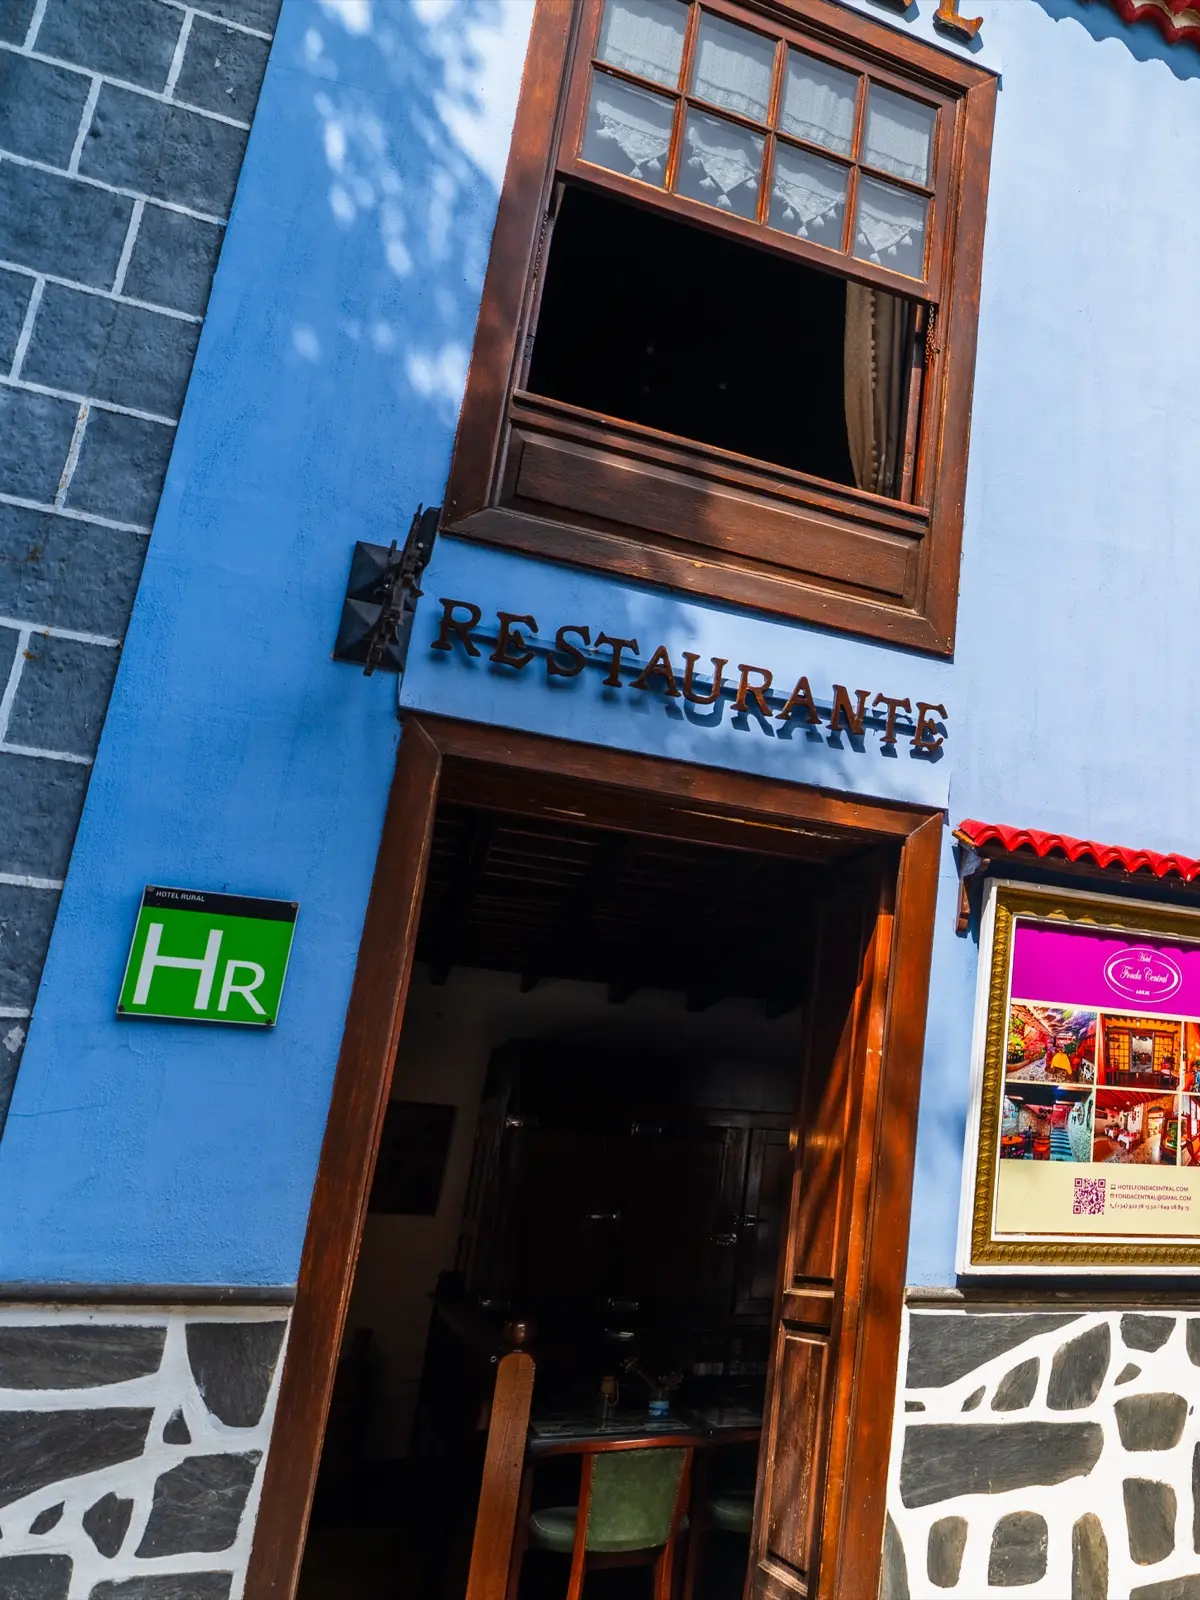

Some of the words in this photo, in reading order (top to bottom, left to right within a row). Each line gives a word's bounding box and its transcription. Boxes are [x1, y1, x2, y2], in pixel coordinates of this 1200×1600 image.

[431, 598, 947, 751] RESTAURANTE
[155, 890, 180, 900] HOTEL
[181, 893, 206, 903] RURAL
[132, 922, 267, 1015] HR
[1120, 965, 1142, 980] Fonda
[1144, 967, 1169, 984] Central
[1117, 1184, 1189, 1192] HOTELFONDACENTRAL.COM
[1115, 1193, 1192, 1201] FONDACENTRAL@GMAIL.COM
